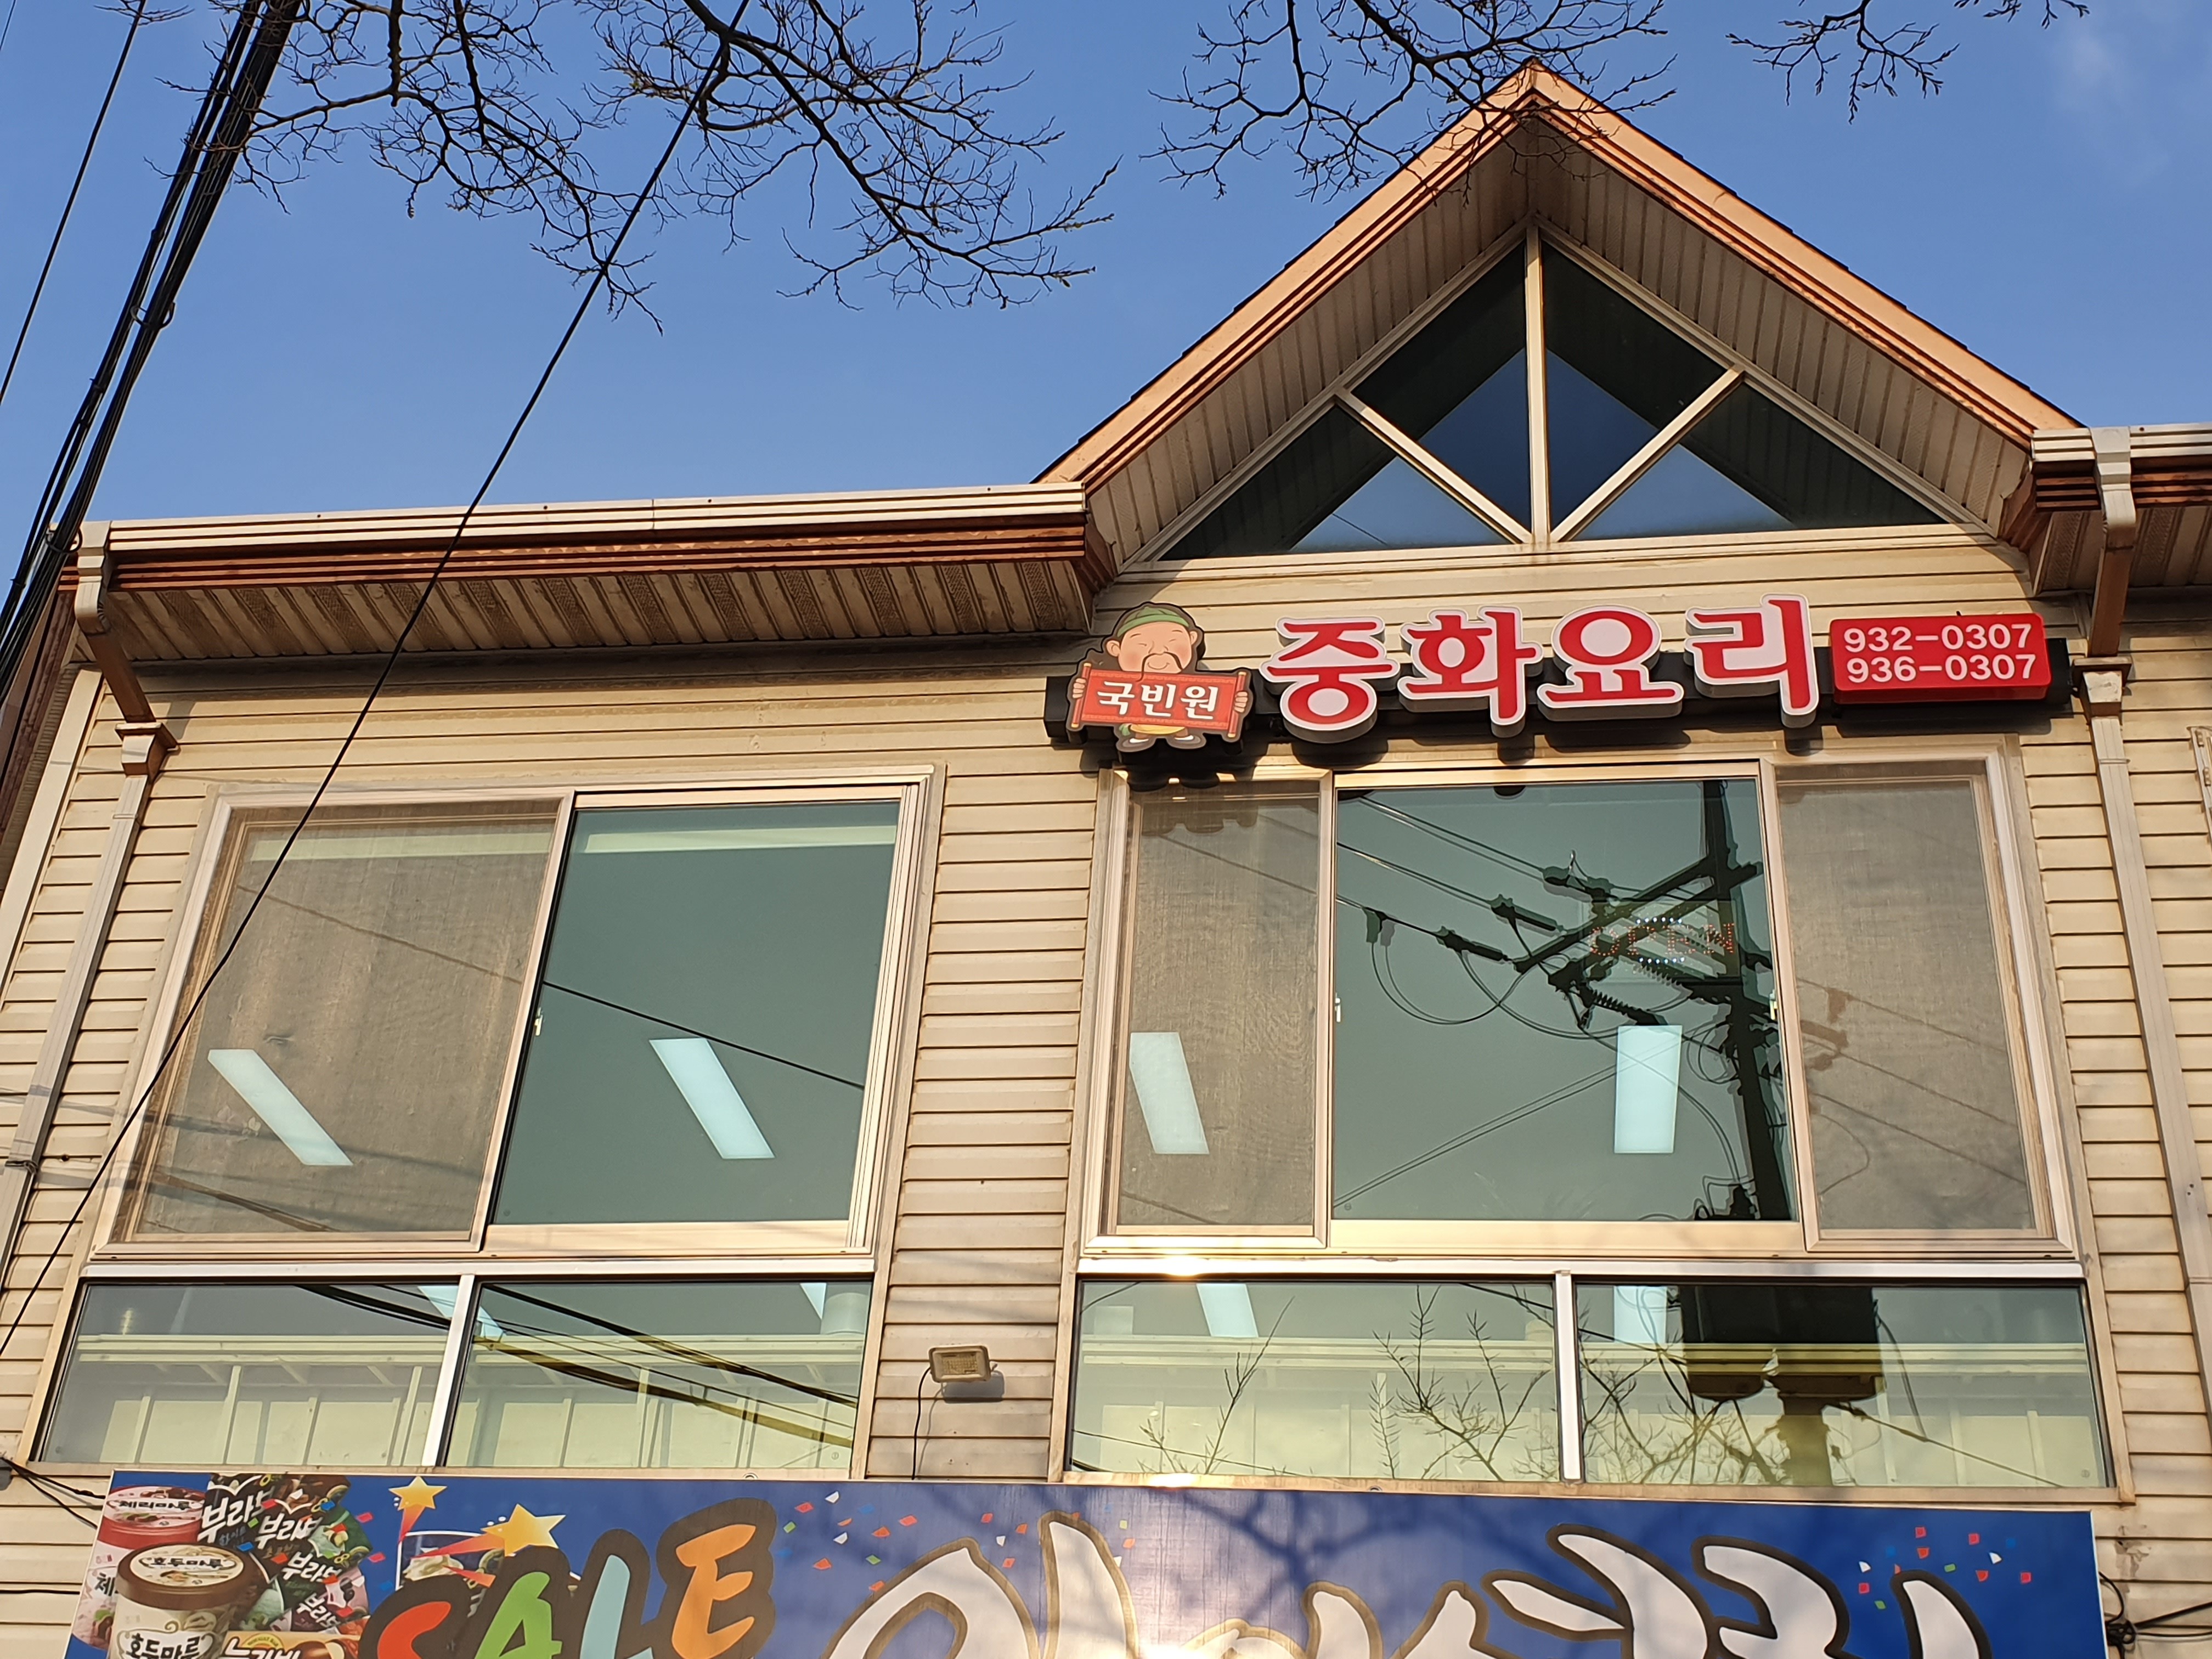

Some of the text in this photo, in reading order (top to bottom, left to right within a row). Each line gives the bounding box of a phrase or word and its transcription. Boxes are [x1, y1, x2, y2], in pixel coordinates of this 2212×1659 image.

[1843, 623, 2032, 653] 932-0307
[1267, 599, 1812, 725] 중화요리
[1847, 654, 2036, 684] 936-0307
[1097, 681, 1218, 720] 국빈원
[1589, 922, 1735, 957] OPEN
